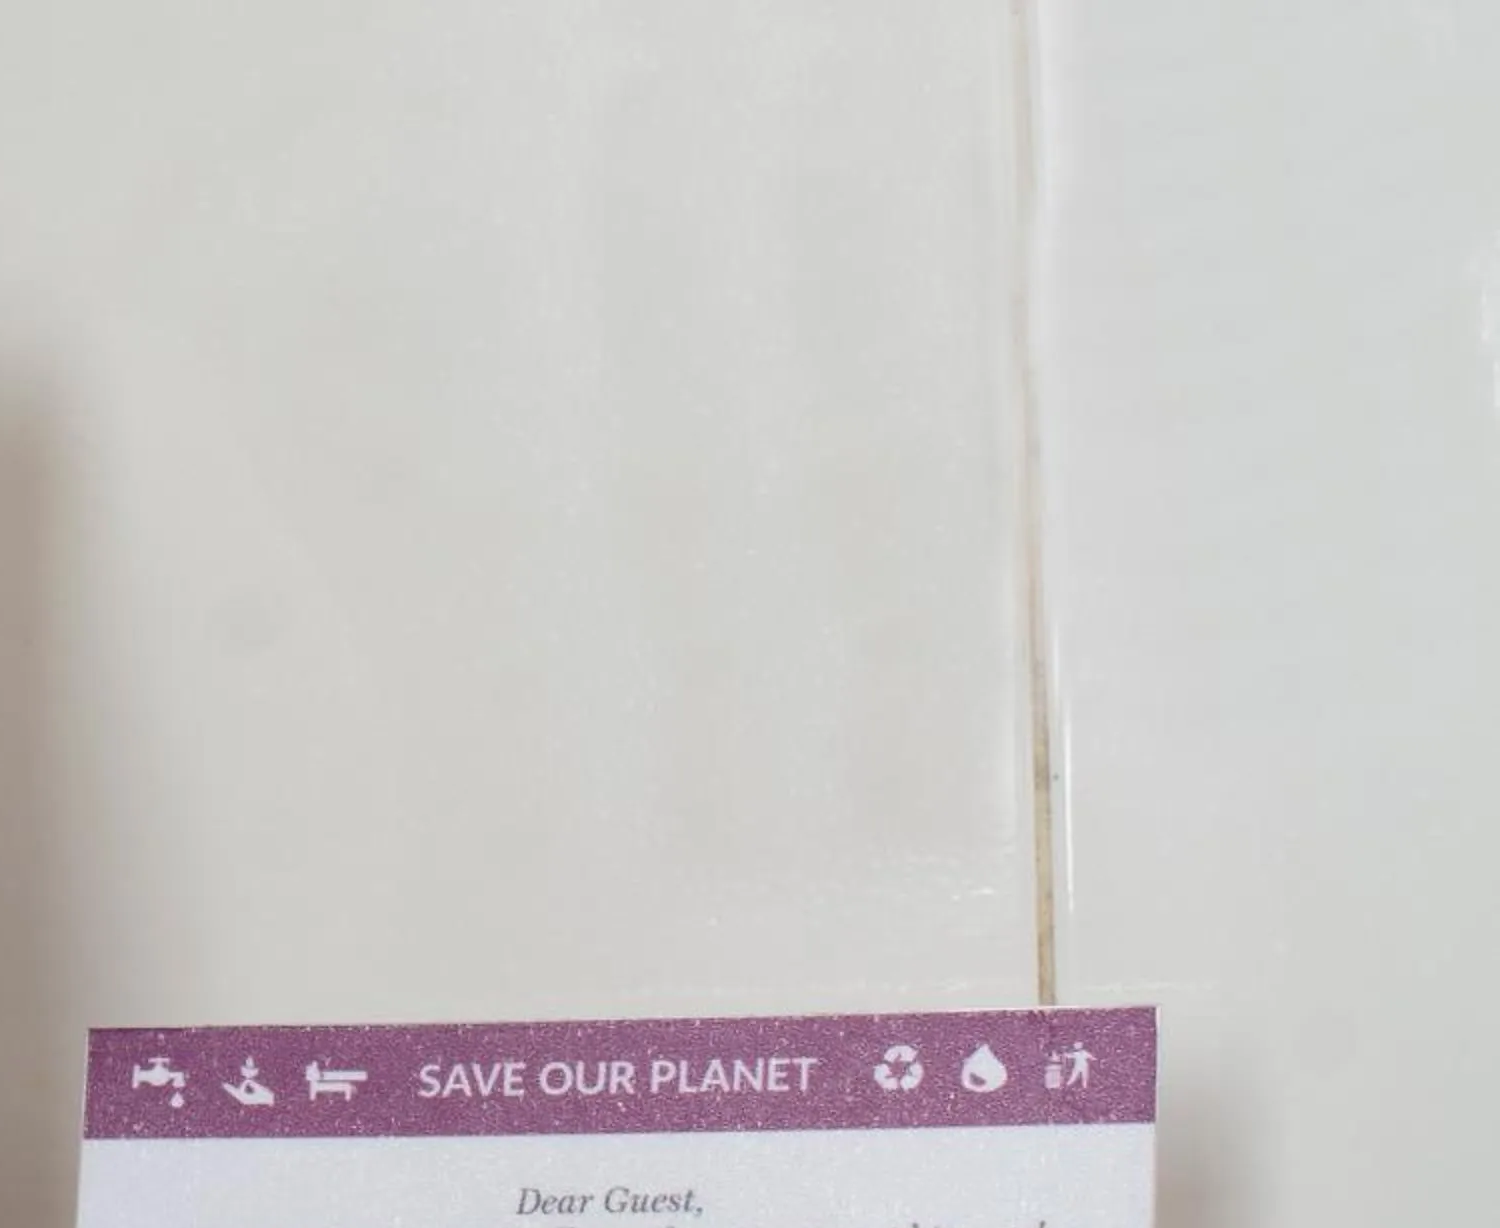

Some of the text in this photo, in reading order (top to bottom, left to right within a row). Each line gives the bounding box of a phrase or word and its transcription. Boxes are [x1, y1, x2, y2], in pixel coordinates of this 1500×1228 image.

[418, 1056, 817, 1098] SAVE OUR PLANET
[516, 1186, 704, 1217] Dear Guest,
